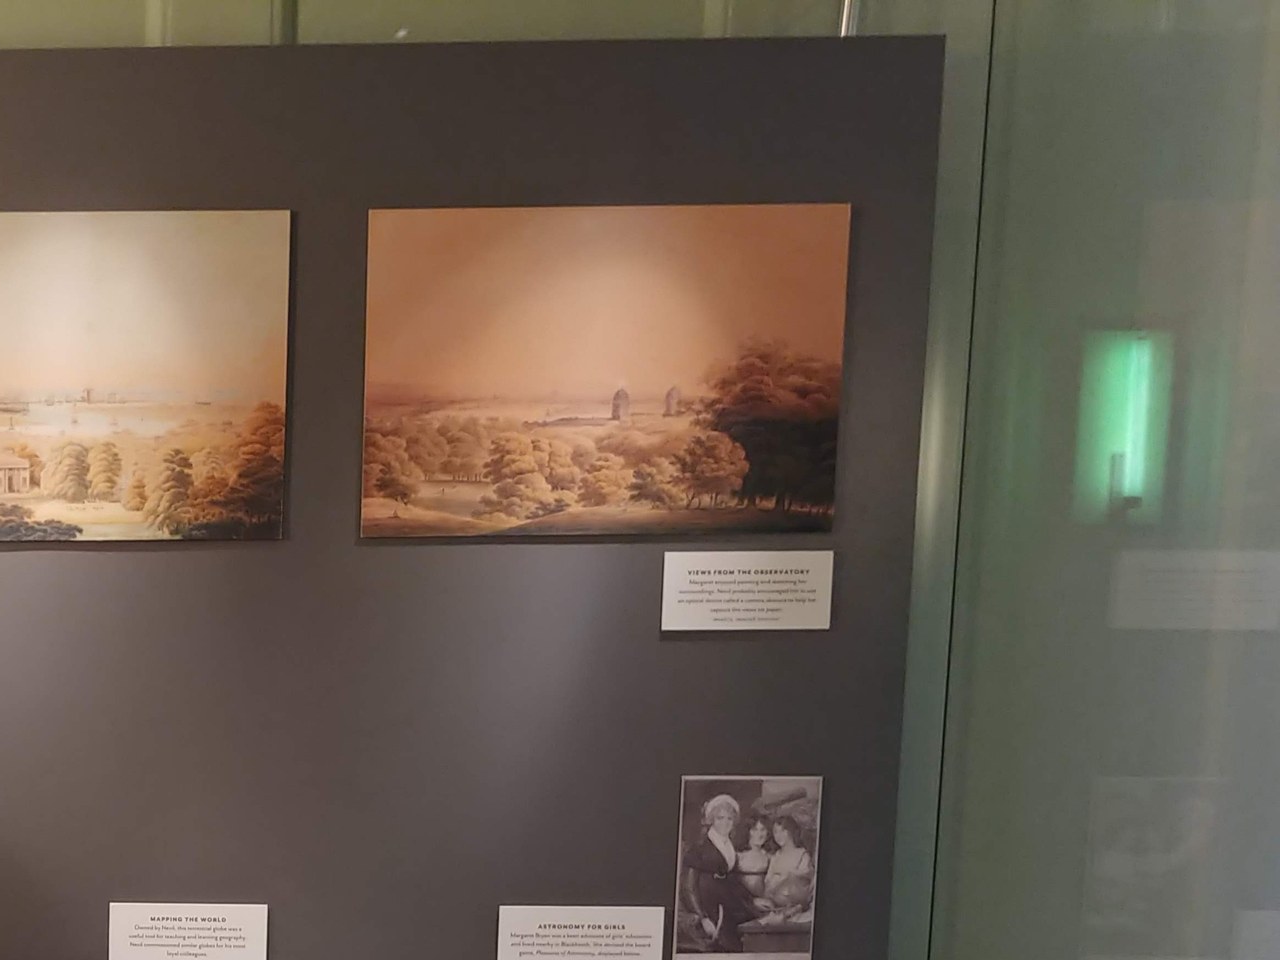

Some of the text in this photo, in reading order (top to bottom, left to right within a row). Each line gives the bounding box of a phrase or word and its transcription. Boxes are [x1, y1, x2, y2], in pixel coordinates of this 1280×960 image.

[737, 568, 752, 576] THE
[753, 568, 810, 576] OBSERVATORY
[197, 934, 218, 942] learning
